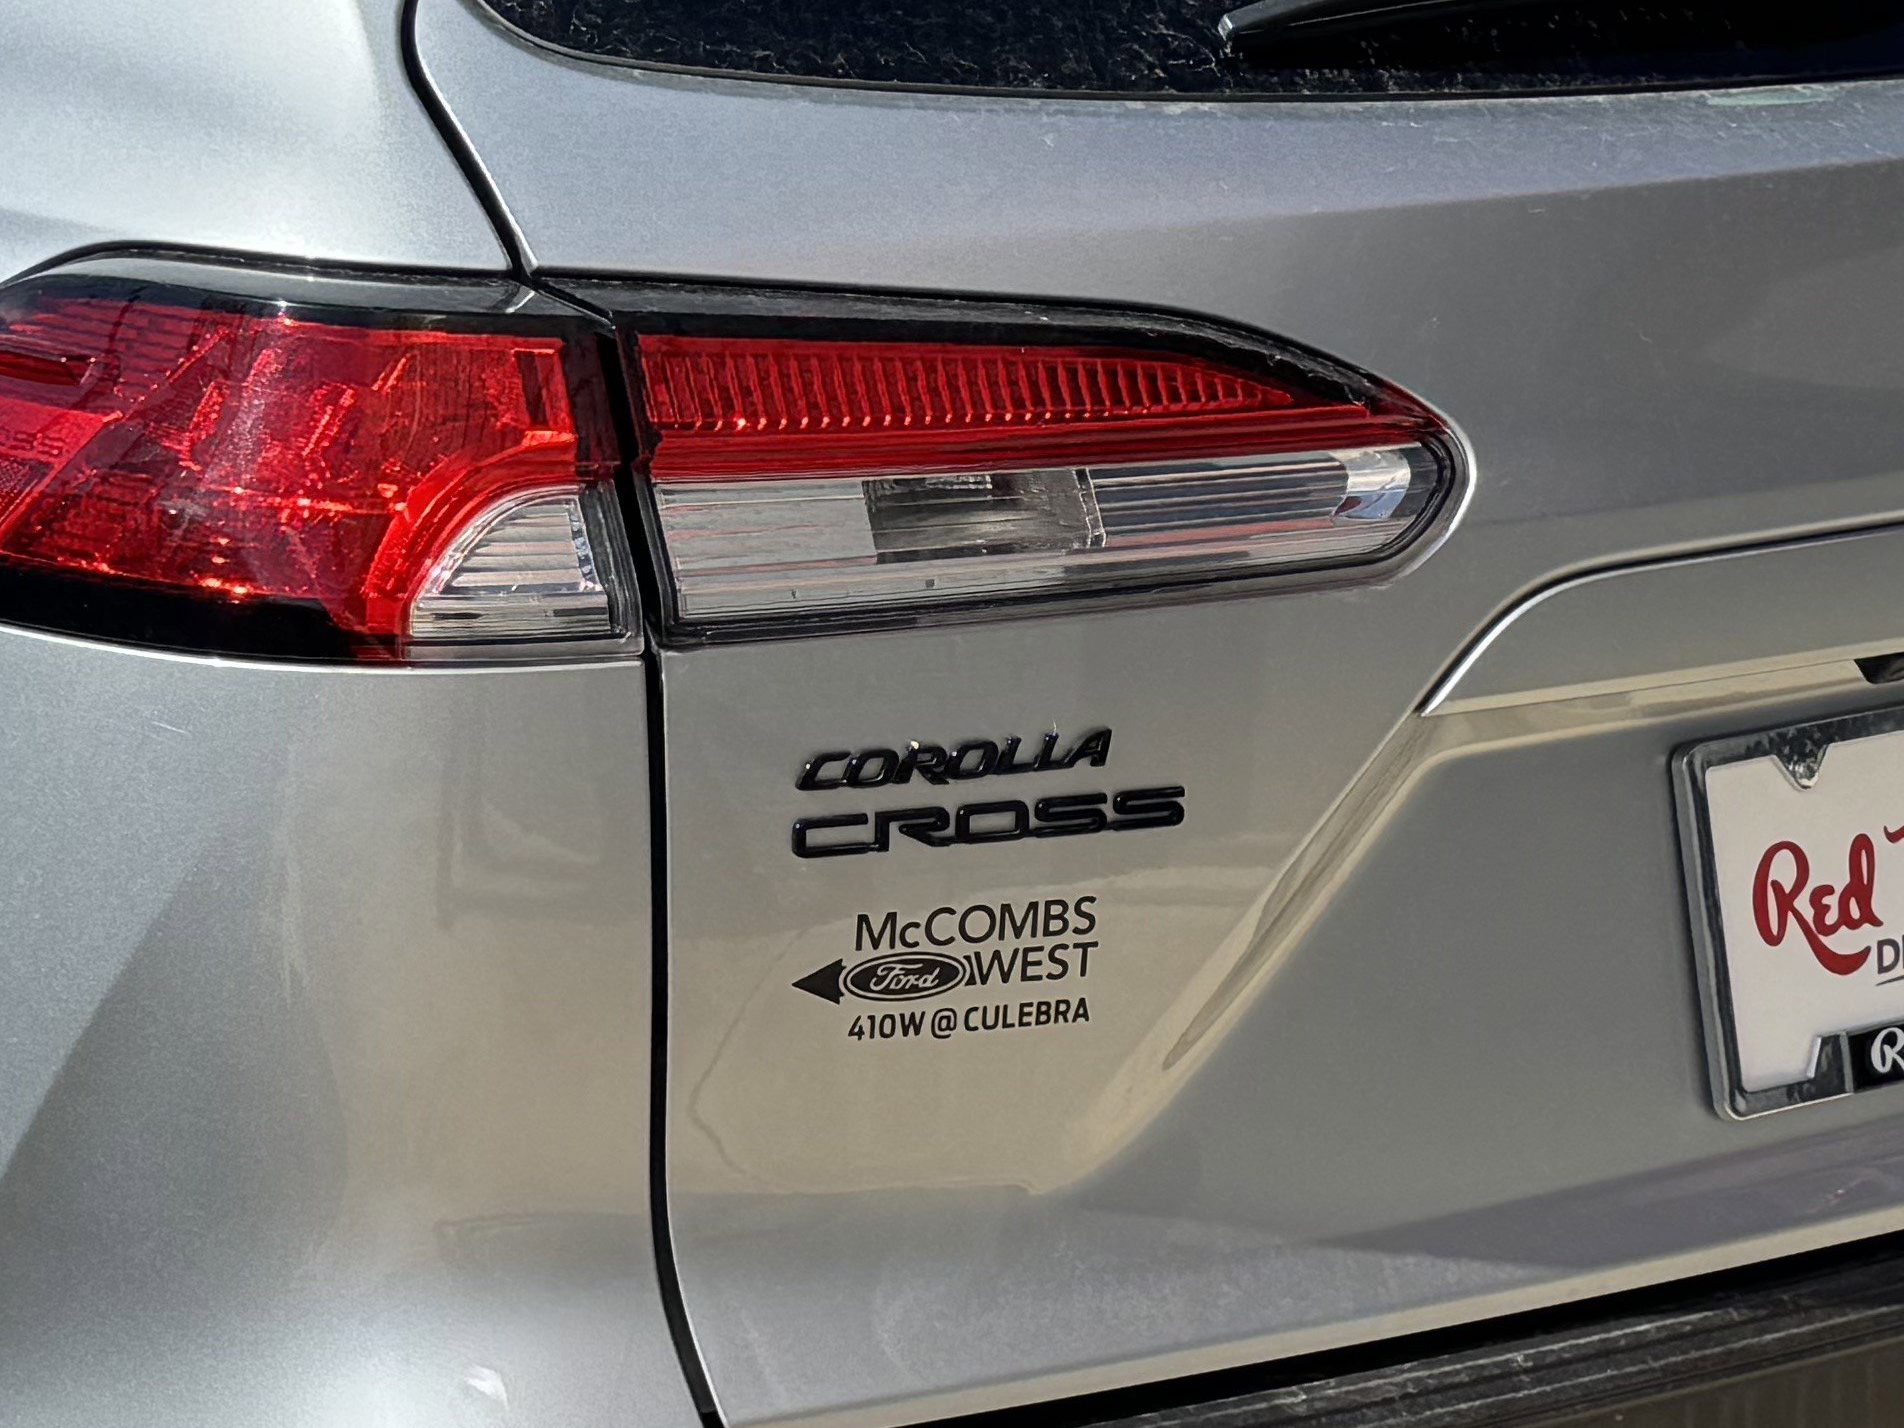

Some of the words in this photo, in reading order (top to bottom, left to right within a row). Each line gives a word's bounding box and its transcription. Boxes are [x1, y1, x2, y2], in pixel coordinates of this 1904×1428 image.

[795, 727, 1113, 792] COROLLA
[791, 785, 1186, 859] CROSS
[854, 895, 1098, 952] McCOMBS
[1752, 832, 1884, 976] Red
[869, 963, 941, 993] Ford
[973, 941, 1100, 986] WEST
[847, 1010, 926, 1042] 410W
[930, 1007, 958, 1040] @
[964, 997, 1091, 1032] CULEBRA
